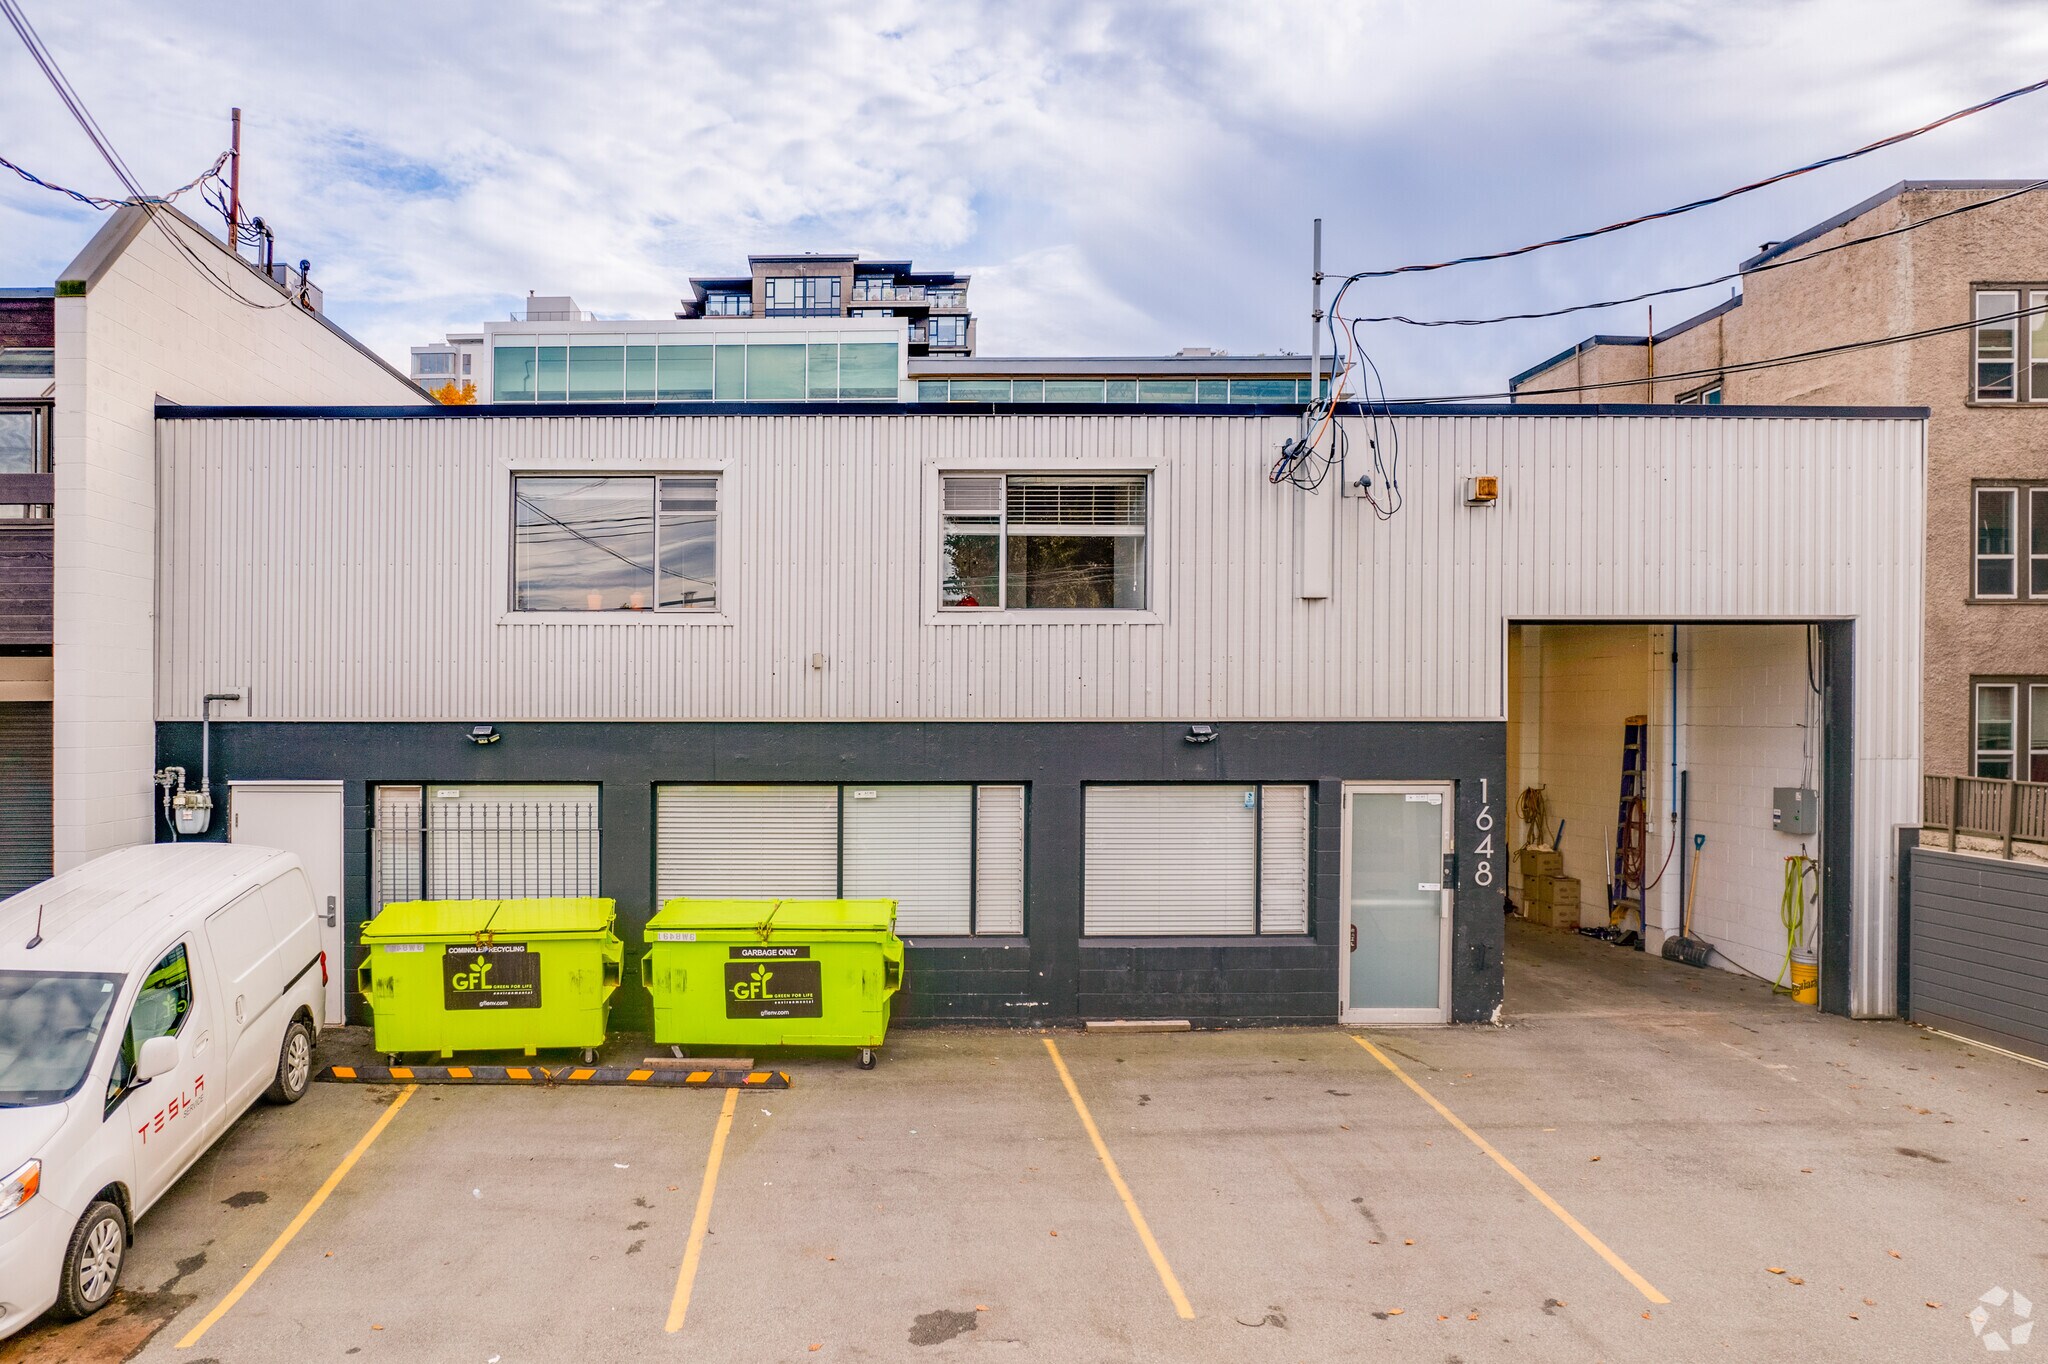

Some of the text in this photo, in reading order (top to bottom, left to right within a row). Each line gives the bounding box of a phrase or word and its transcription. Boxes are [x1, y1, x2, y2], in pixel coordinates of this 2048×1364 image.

[1474, 778, 1494, 886] 1648
[778, 948, 798, 956] ONLY
[452, 963, 493, 990] GFL
[733, 972, 773, 999] GFL
[138, 1074, 204, 1145] TESLA
